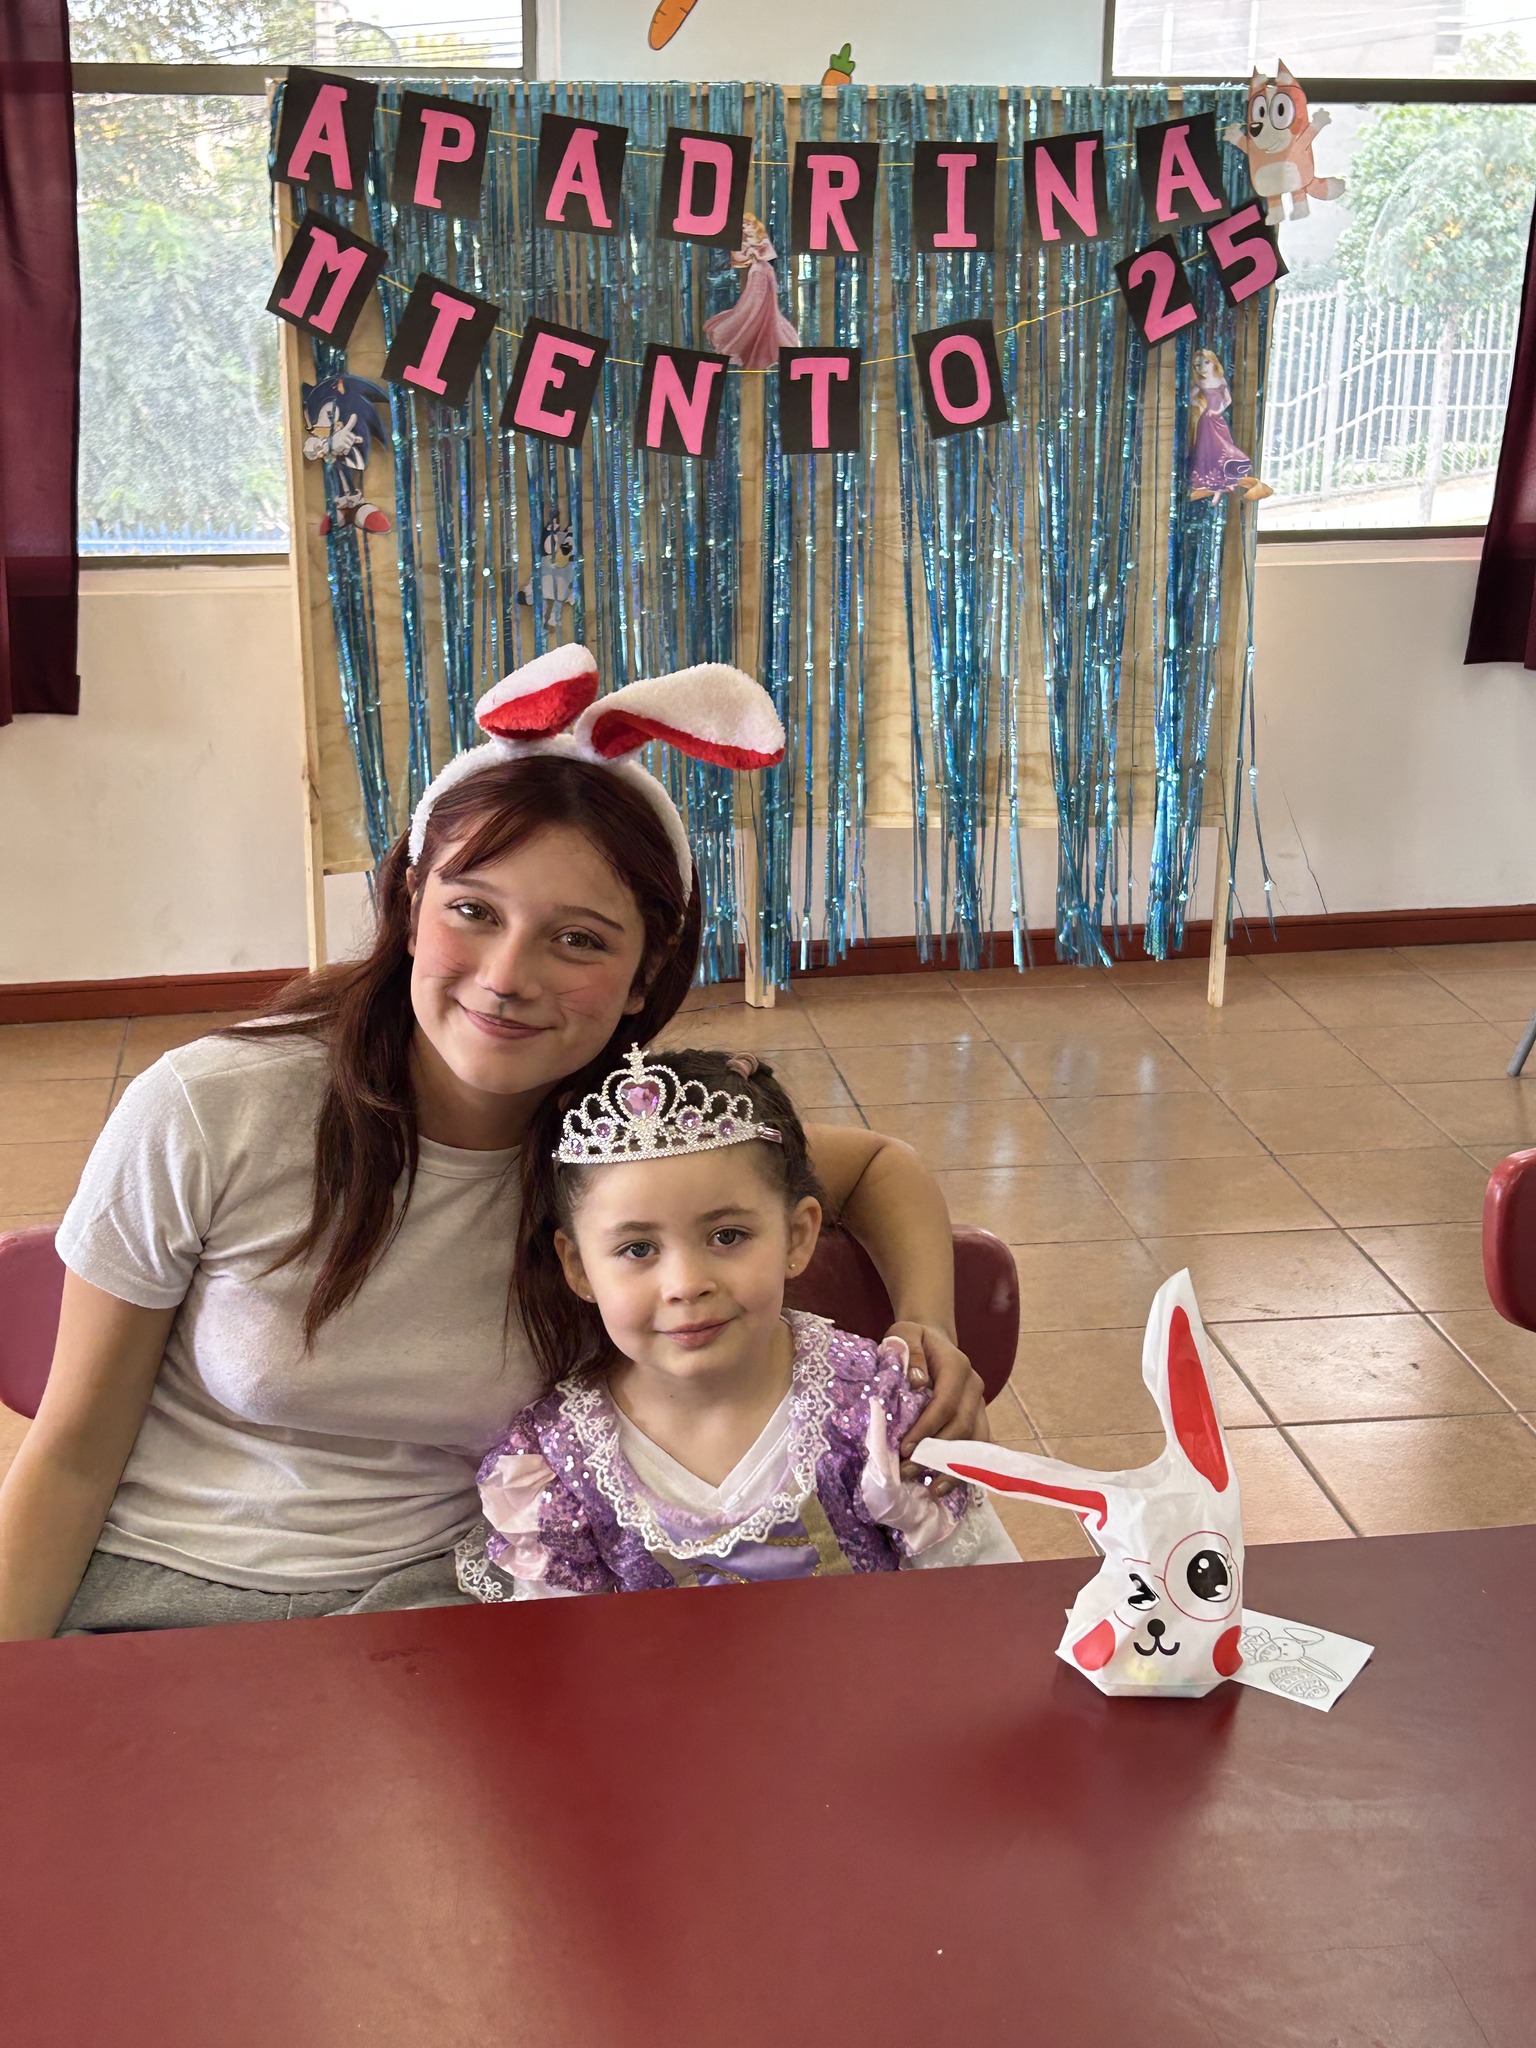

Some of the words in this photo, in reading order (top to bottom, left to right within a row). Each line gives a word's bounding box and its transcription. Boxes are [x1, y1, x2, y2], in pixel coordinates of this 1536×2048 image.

[287, 84, 1222, 252] APADRINA
[279, 226, 992, 456] MIENTO
[1128, 205, 1278, 342] 25
